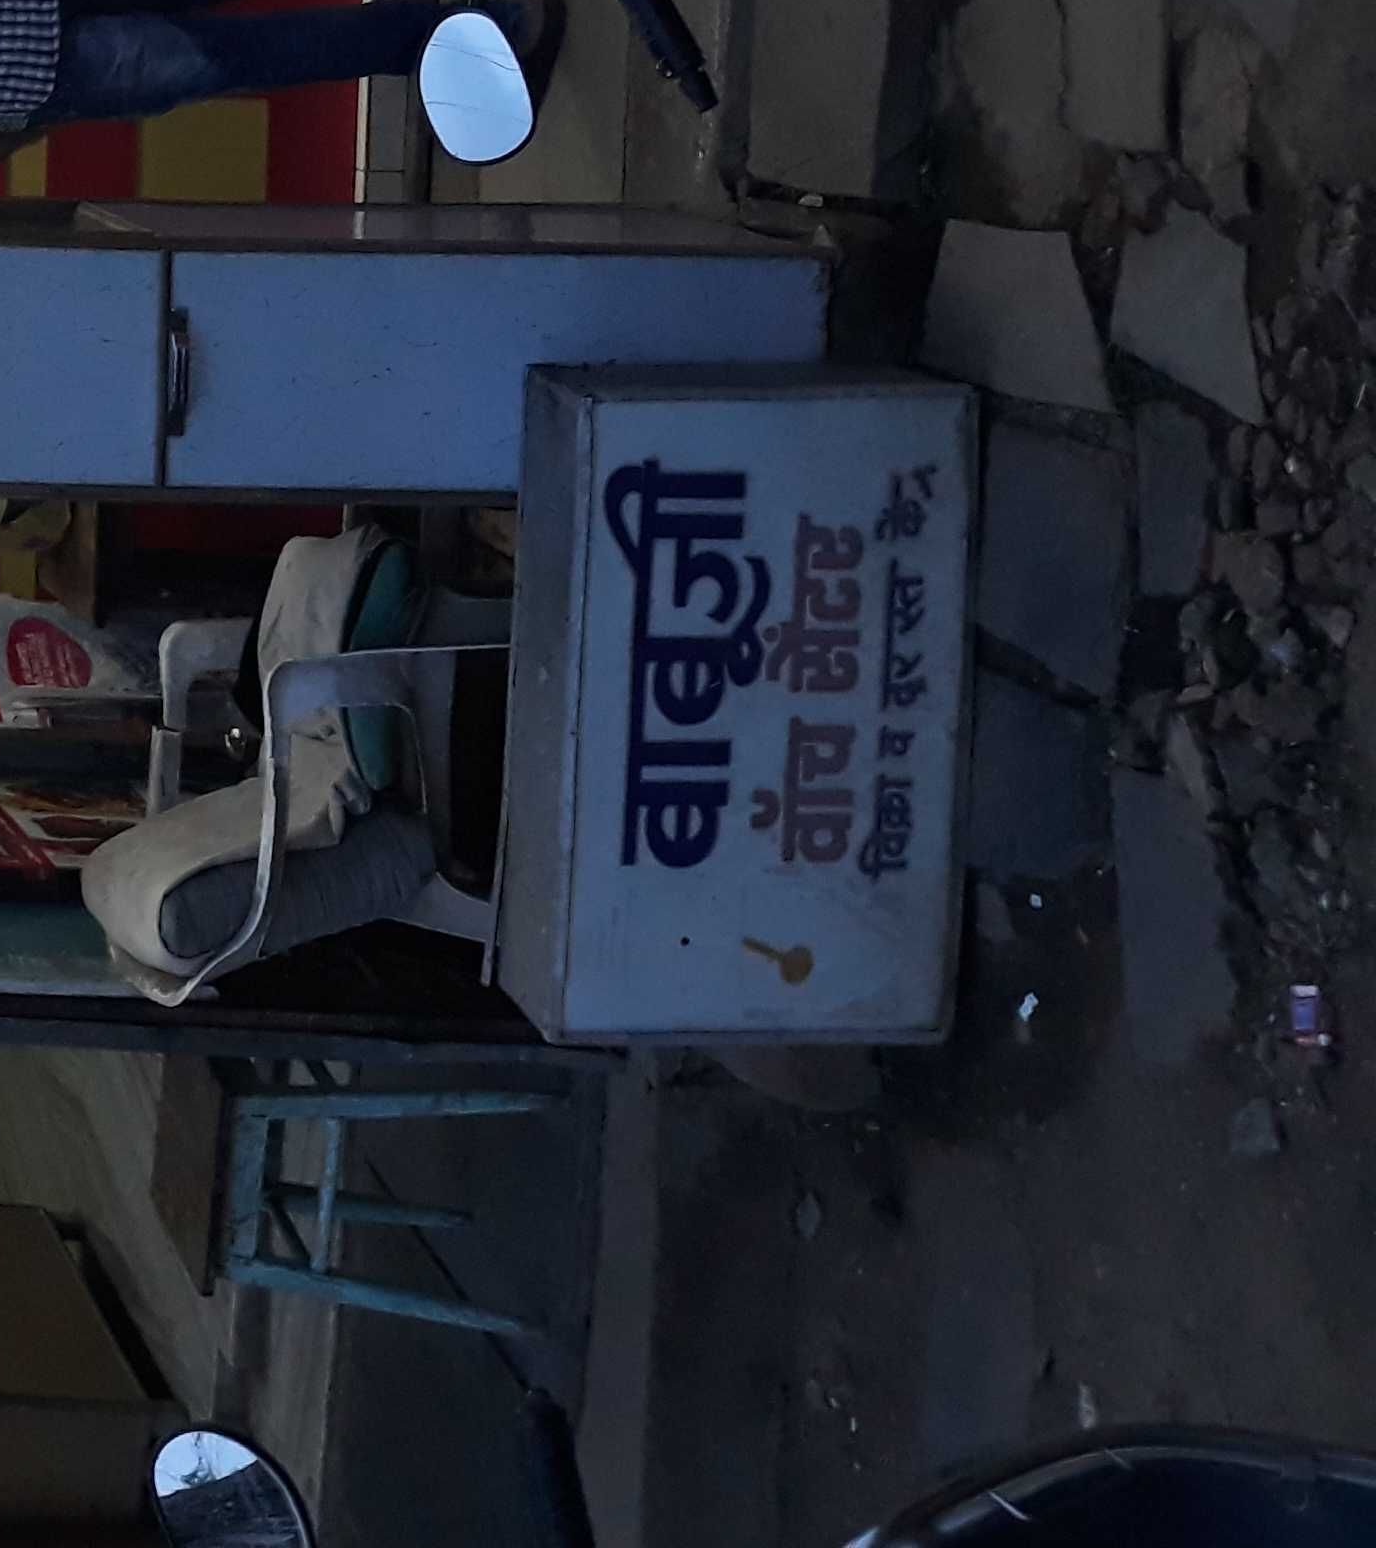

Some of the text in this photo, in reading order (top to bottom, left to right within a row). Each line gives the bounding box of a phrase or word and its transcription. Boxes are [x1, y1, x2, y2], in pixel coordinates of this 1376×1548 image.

[603, 456, 771, 869] बाबूजी
[750, 511, 863, 864] वॉच सेंटर
[877, 725, 914, 758] व
